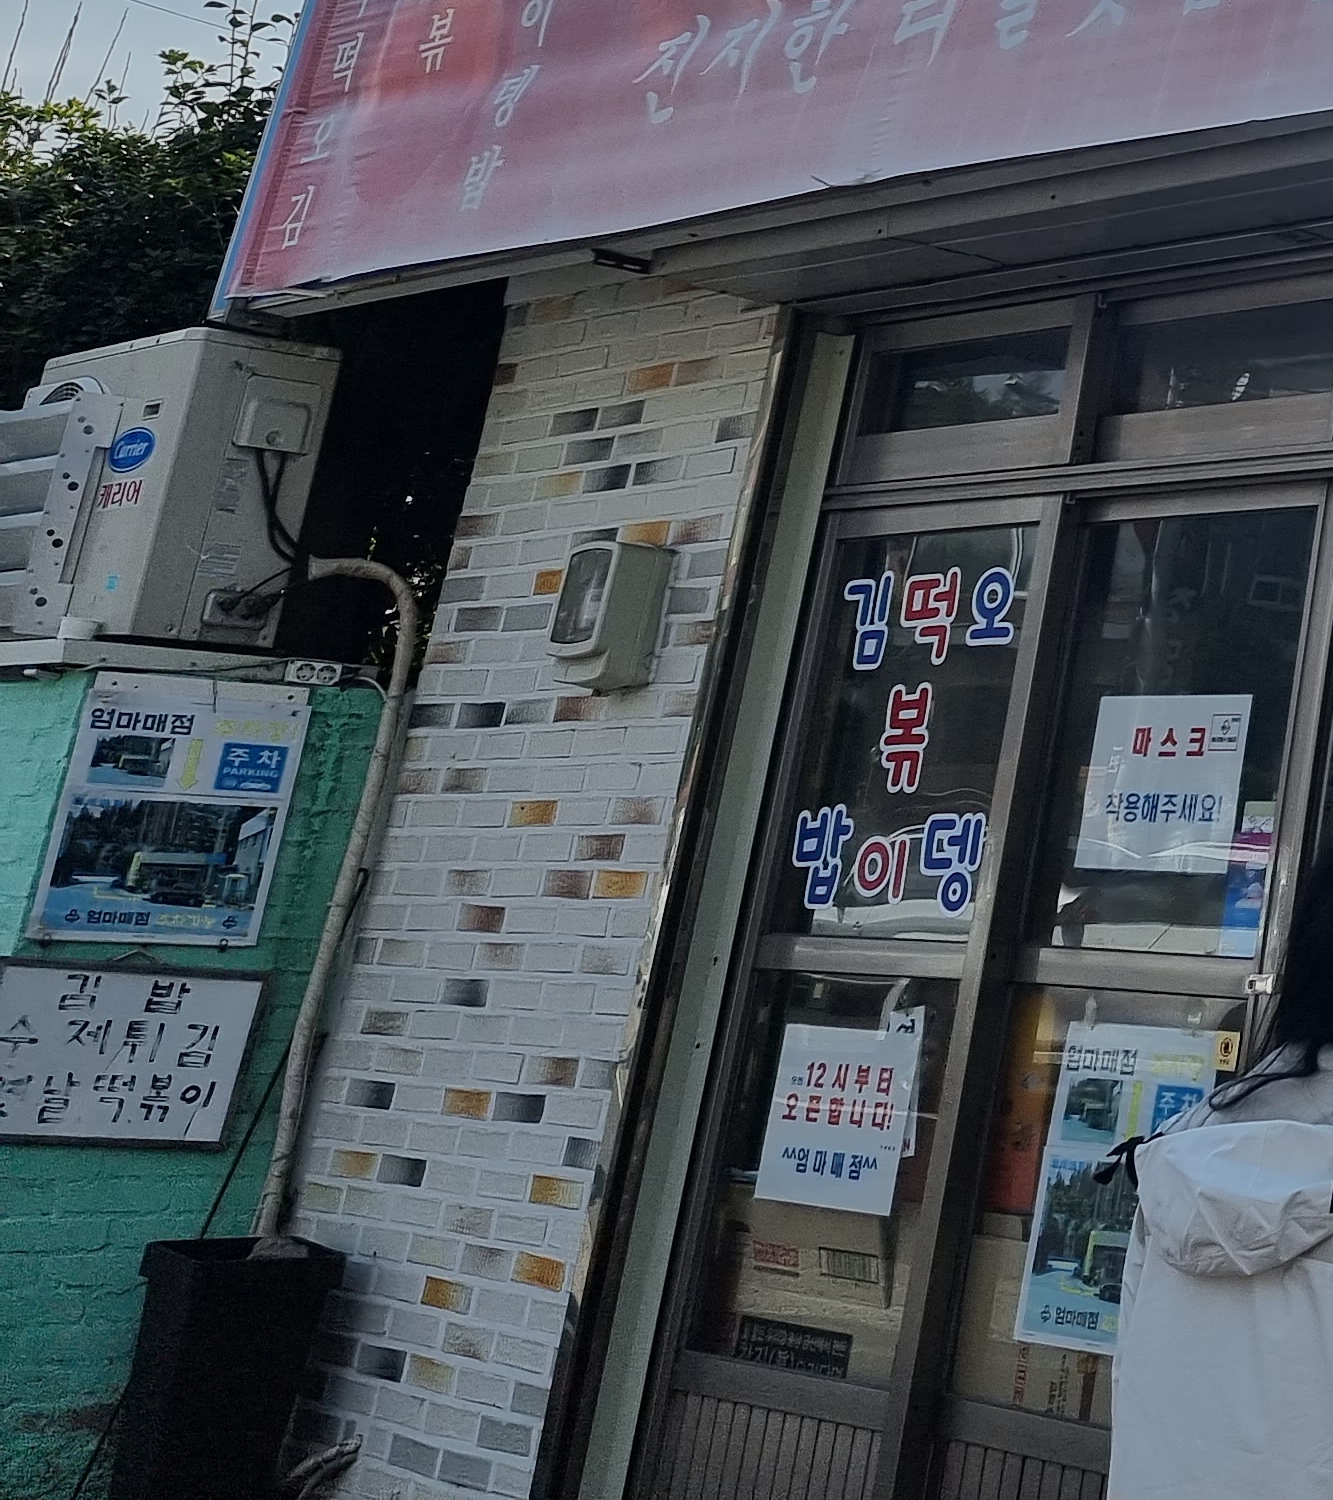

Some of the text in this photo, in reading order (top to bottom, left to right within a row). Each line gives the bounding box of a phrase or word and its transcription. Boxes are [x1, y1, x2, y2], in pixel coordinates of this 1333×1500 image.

[280, 144, 507, 250] 김밥
[114, 438, 149, 460] Carrier
[97, 479, 144, 509] 캐리어
[89, 707, 196, 736] 엄마매점
[1131, 725, 1207, 758] 마스크
[222, 767, 279, 778] PARKING
[227, 747, 281, 769] 주차
[86, 908, 152, 927] 엄마매점
[58, 973, 192, 1015] 김밥
[1066, 1045, 1139, 1077] 엄마매점
[1055, 1306, 1100, 1331] 엄마매점
